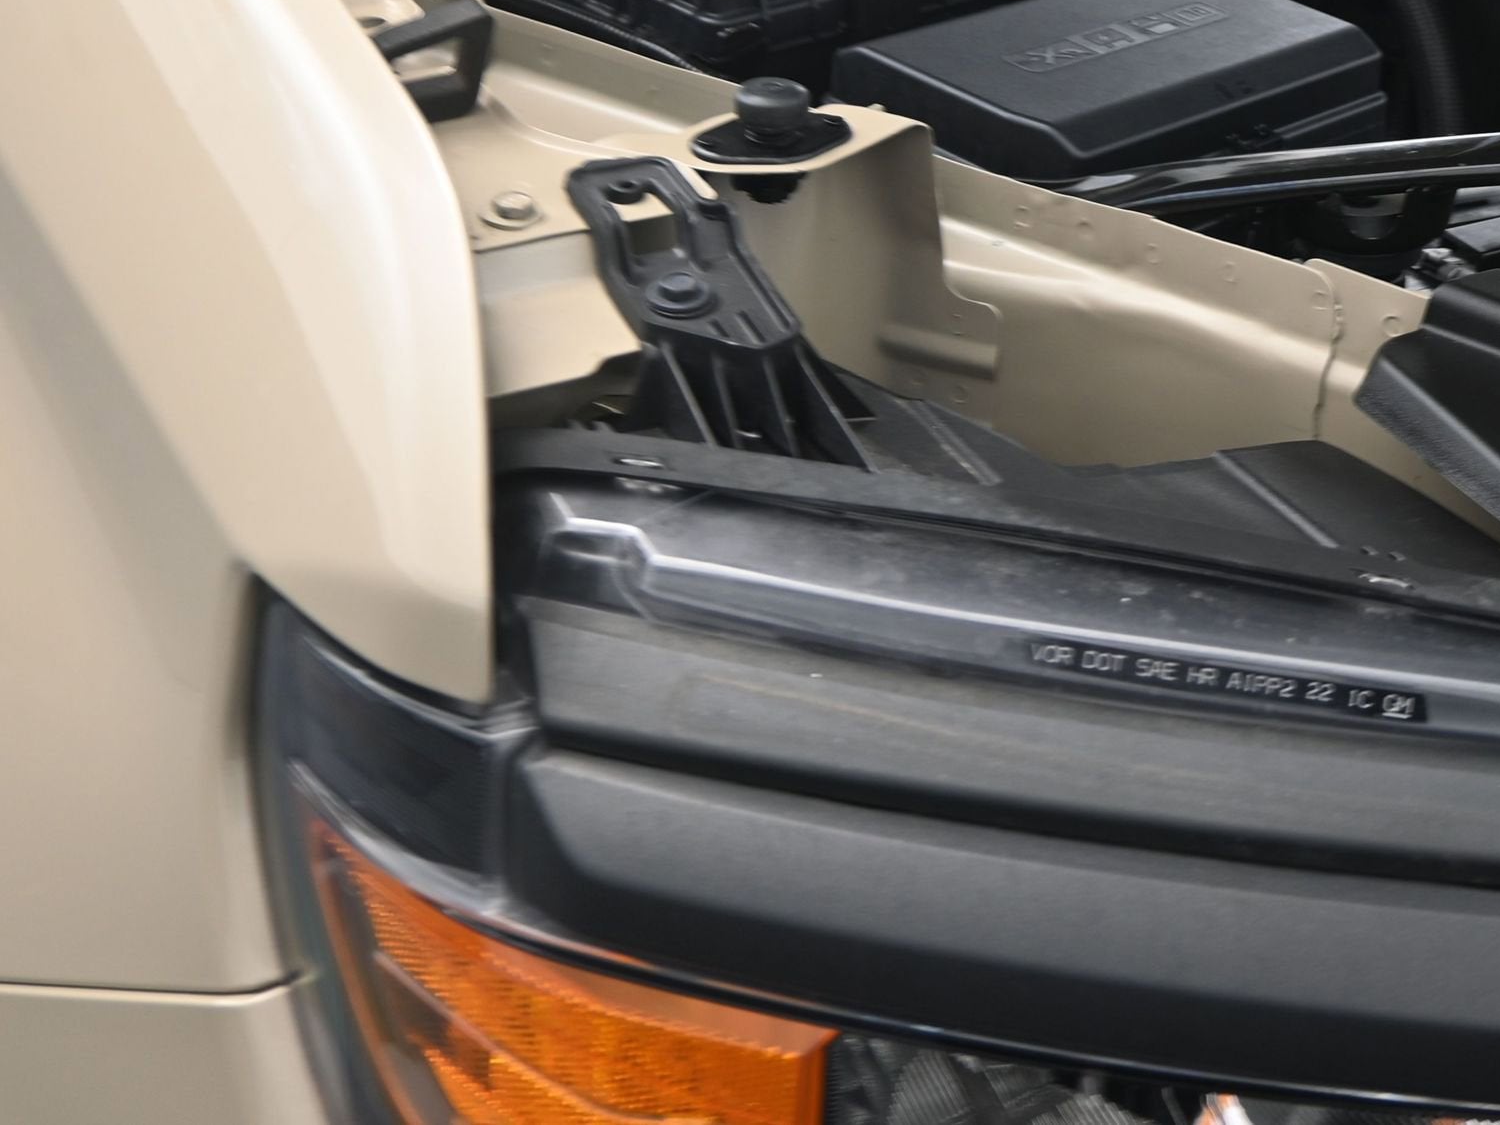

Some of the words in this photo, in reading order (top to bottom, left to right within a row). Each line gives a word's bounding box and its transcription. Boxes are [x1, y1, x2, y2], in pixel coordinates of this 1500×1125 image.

[1081, 650, 1127, 672] DOT
[1135, 658, 1180, 681] SAE
[1186, 667, 1220, 686] HR
[1305, 681, 1336, 701] 22
